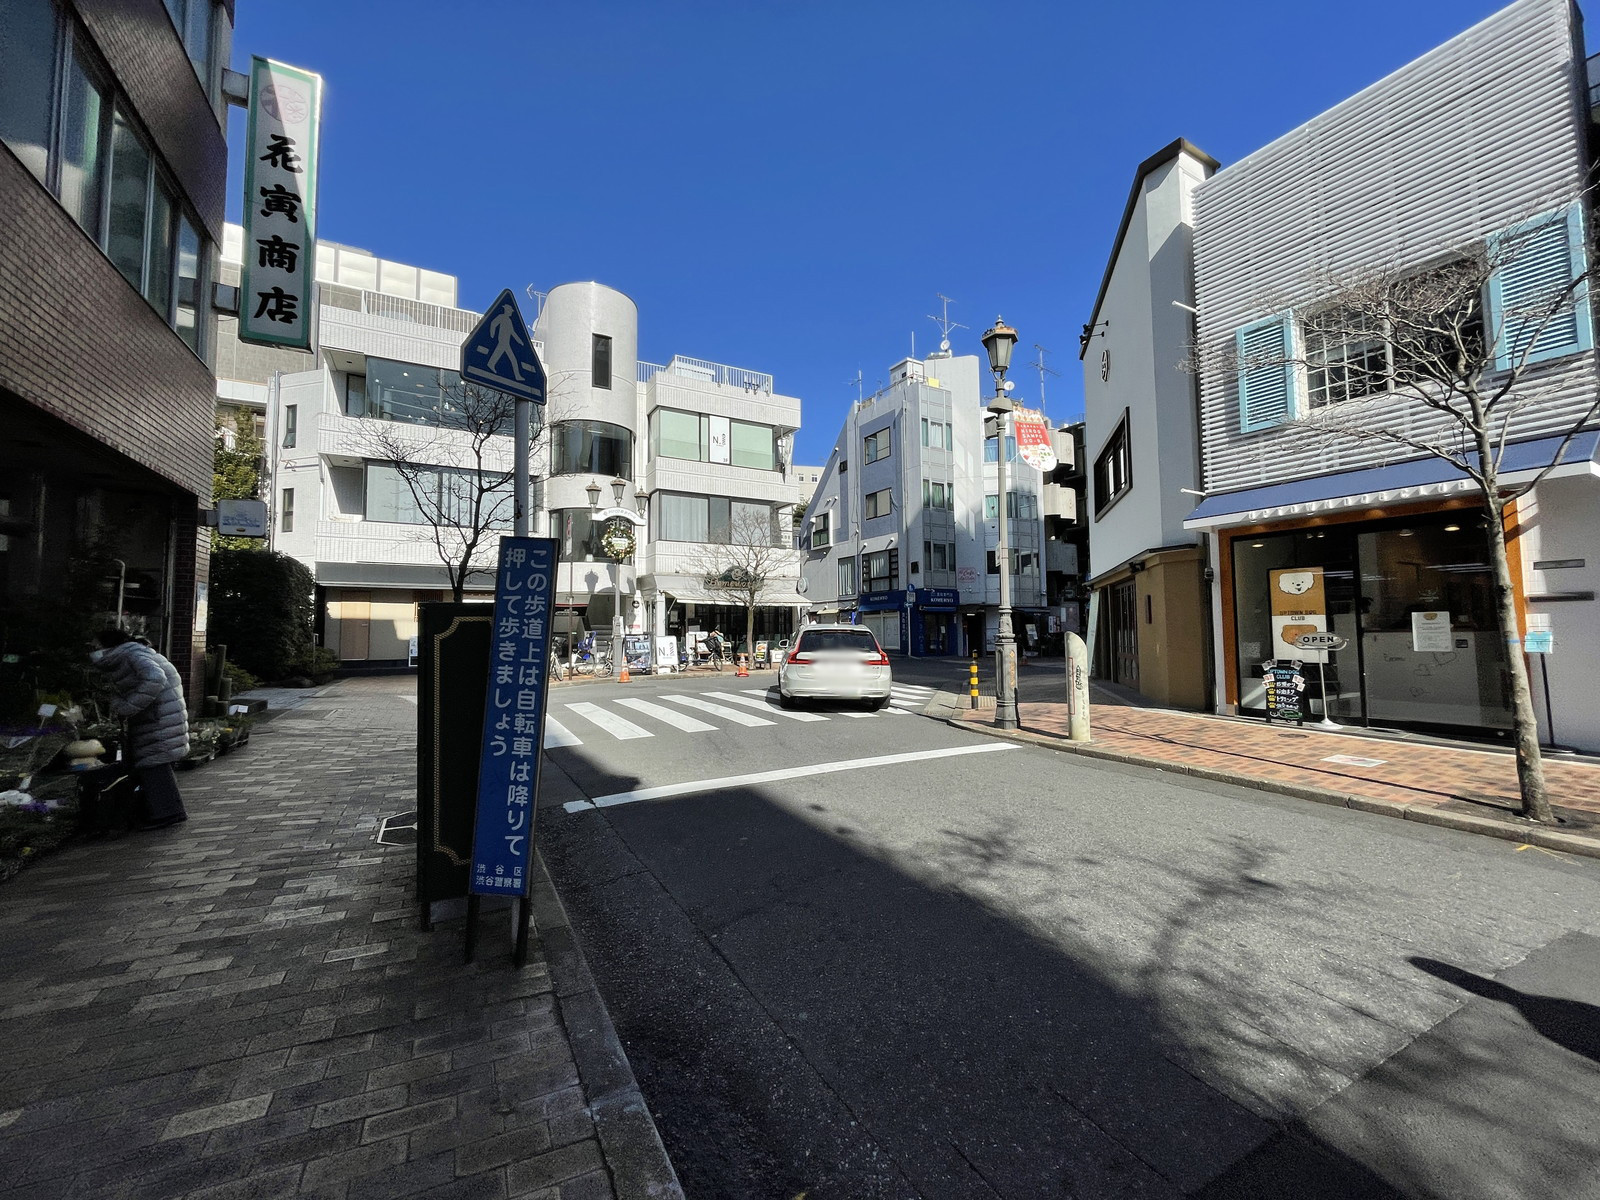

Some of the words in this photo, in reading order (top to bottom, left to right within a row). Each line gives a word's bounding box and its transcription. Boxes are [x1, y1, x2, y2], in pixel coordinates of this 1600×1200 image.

[253, 133, 303, 325] 花寅商店
[489, 547, 526, 758] 押して歩きましょう
[504, 548, 549, 856] この歩道上は自転車は降りて
[475, 875, 521, 889] 渋谷警察署
[476, 863, 523, 877] 渋谷区
